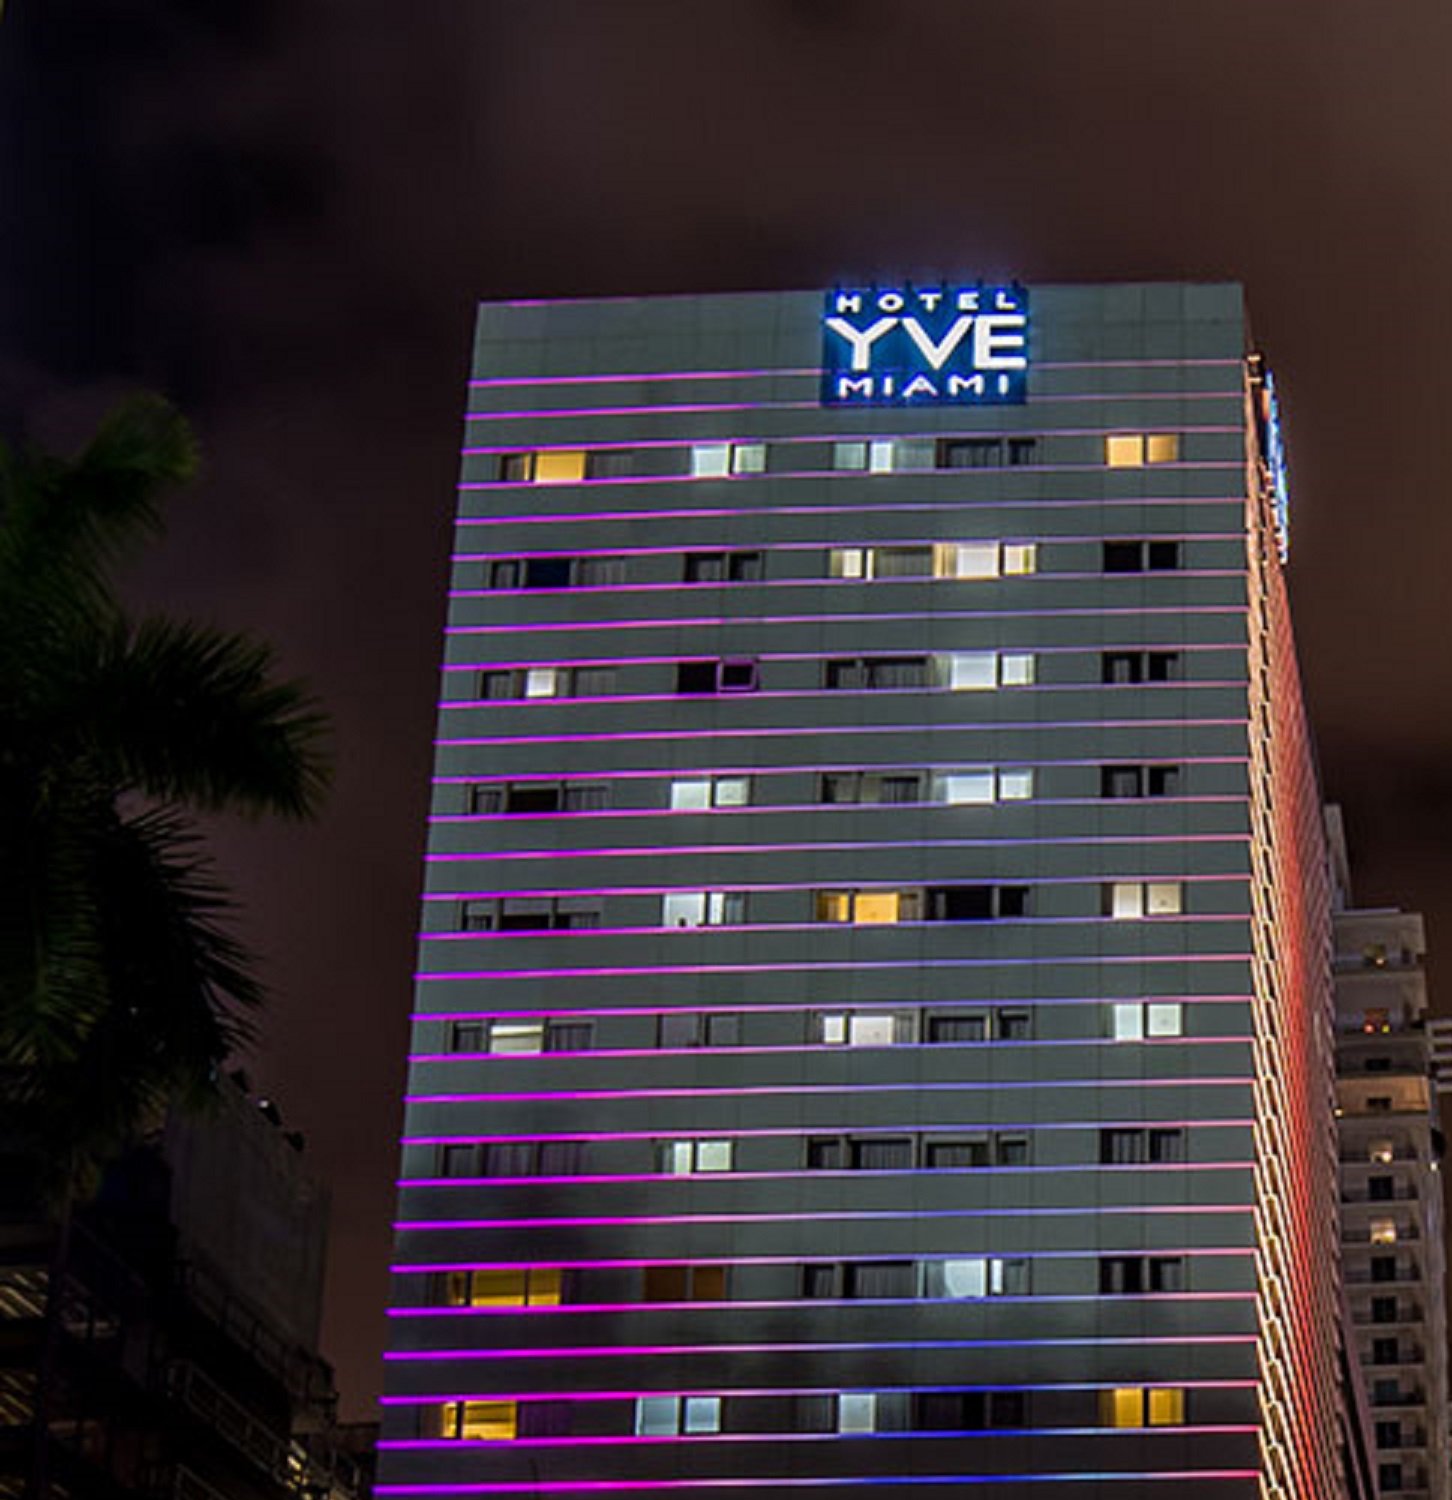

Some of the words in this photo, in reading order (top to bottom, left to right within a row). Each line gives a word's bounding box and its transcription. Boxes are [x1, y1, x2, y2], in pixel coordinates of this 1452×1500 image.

[836, 291, 1016, 313] HOTEL
[825, 315, 1027, 370] YVE
[838, 373, 1009, 397] MIAMI
